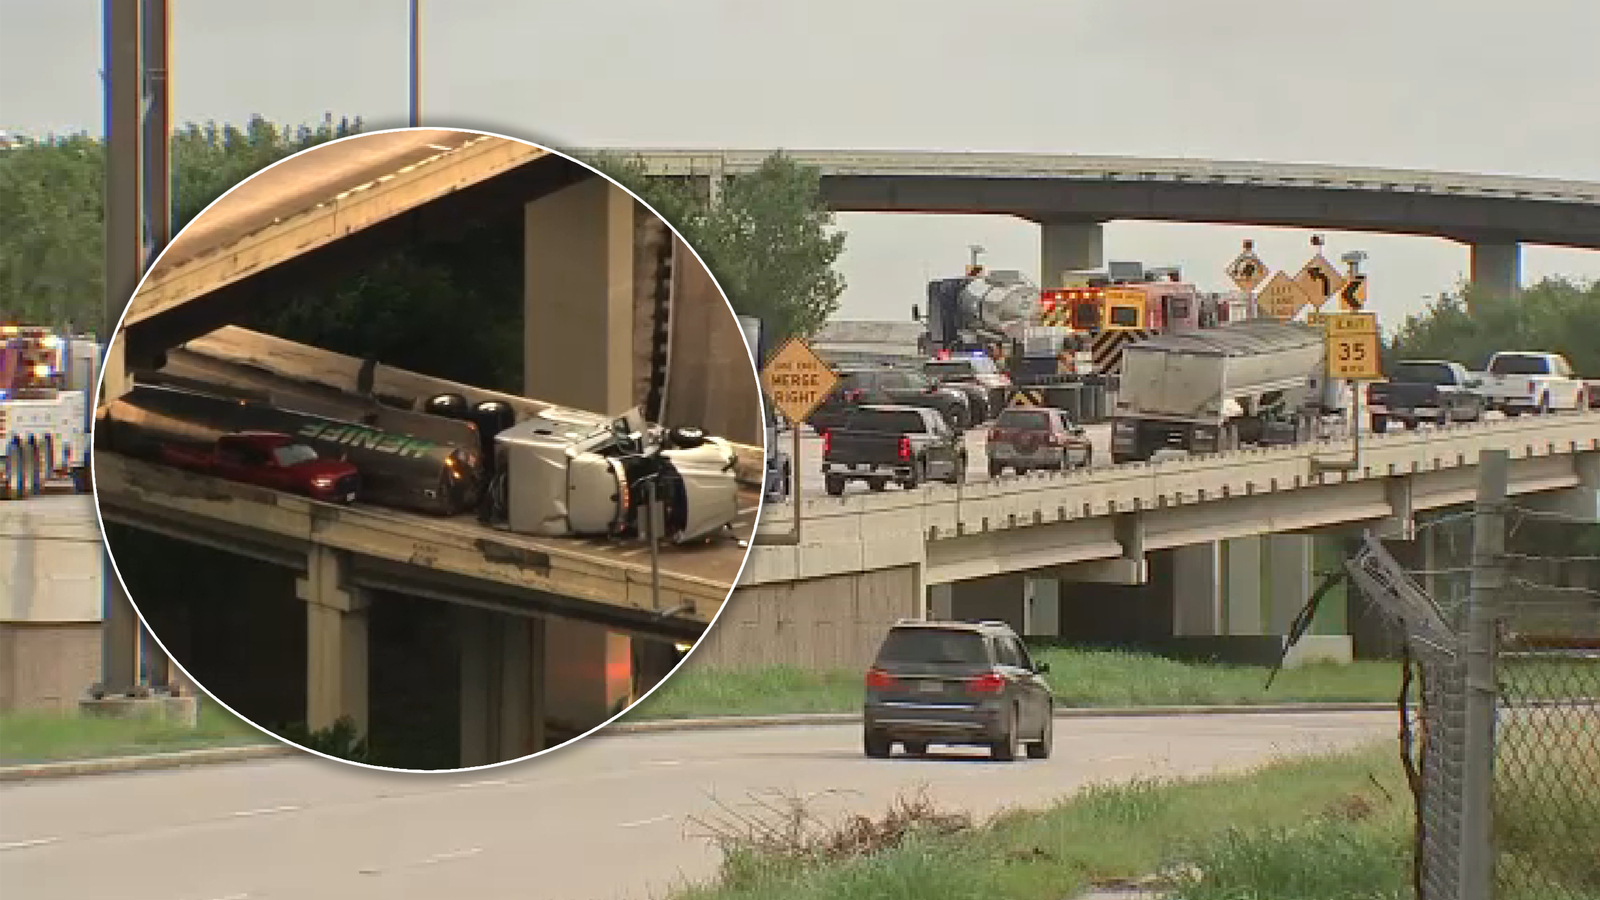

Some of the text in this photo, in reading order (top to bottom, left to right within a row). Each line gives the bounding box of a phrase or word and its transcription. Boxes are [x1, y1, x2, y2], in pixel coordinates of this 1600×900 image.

[1339, 343, 1365, 361] 35
[771, 373, 820, 386] MERGE
[774, 391, 817, 403] RIGHT
